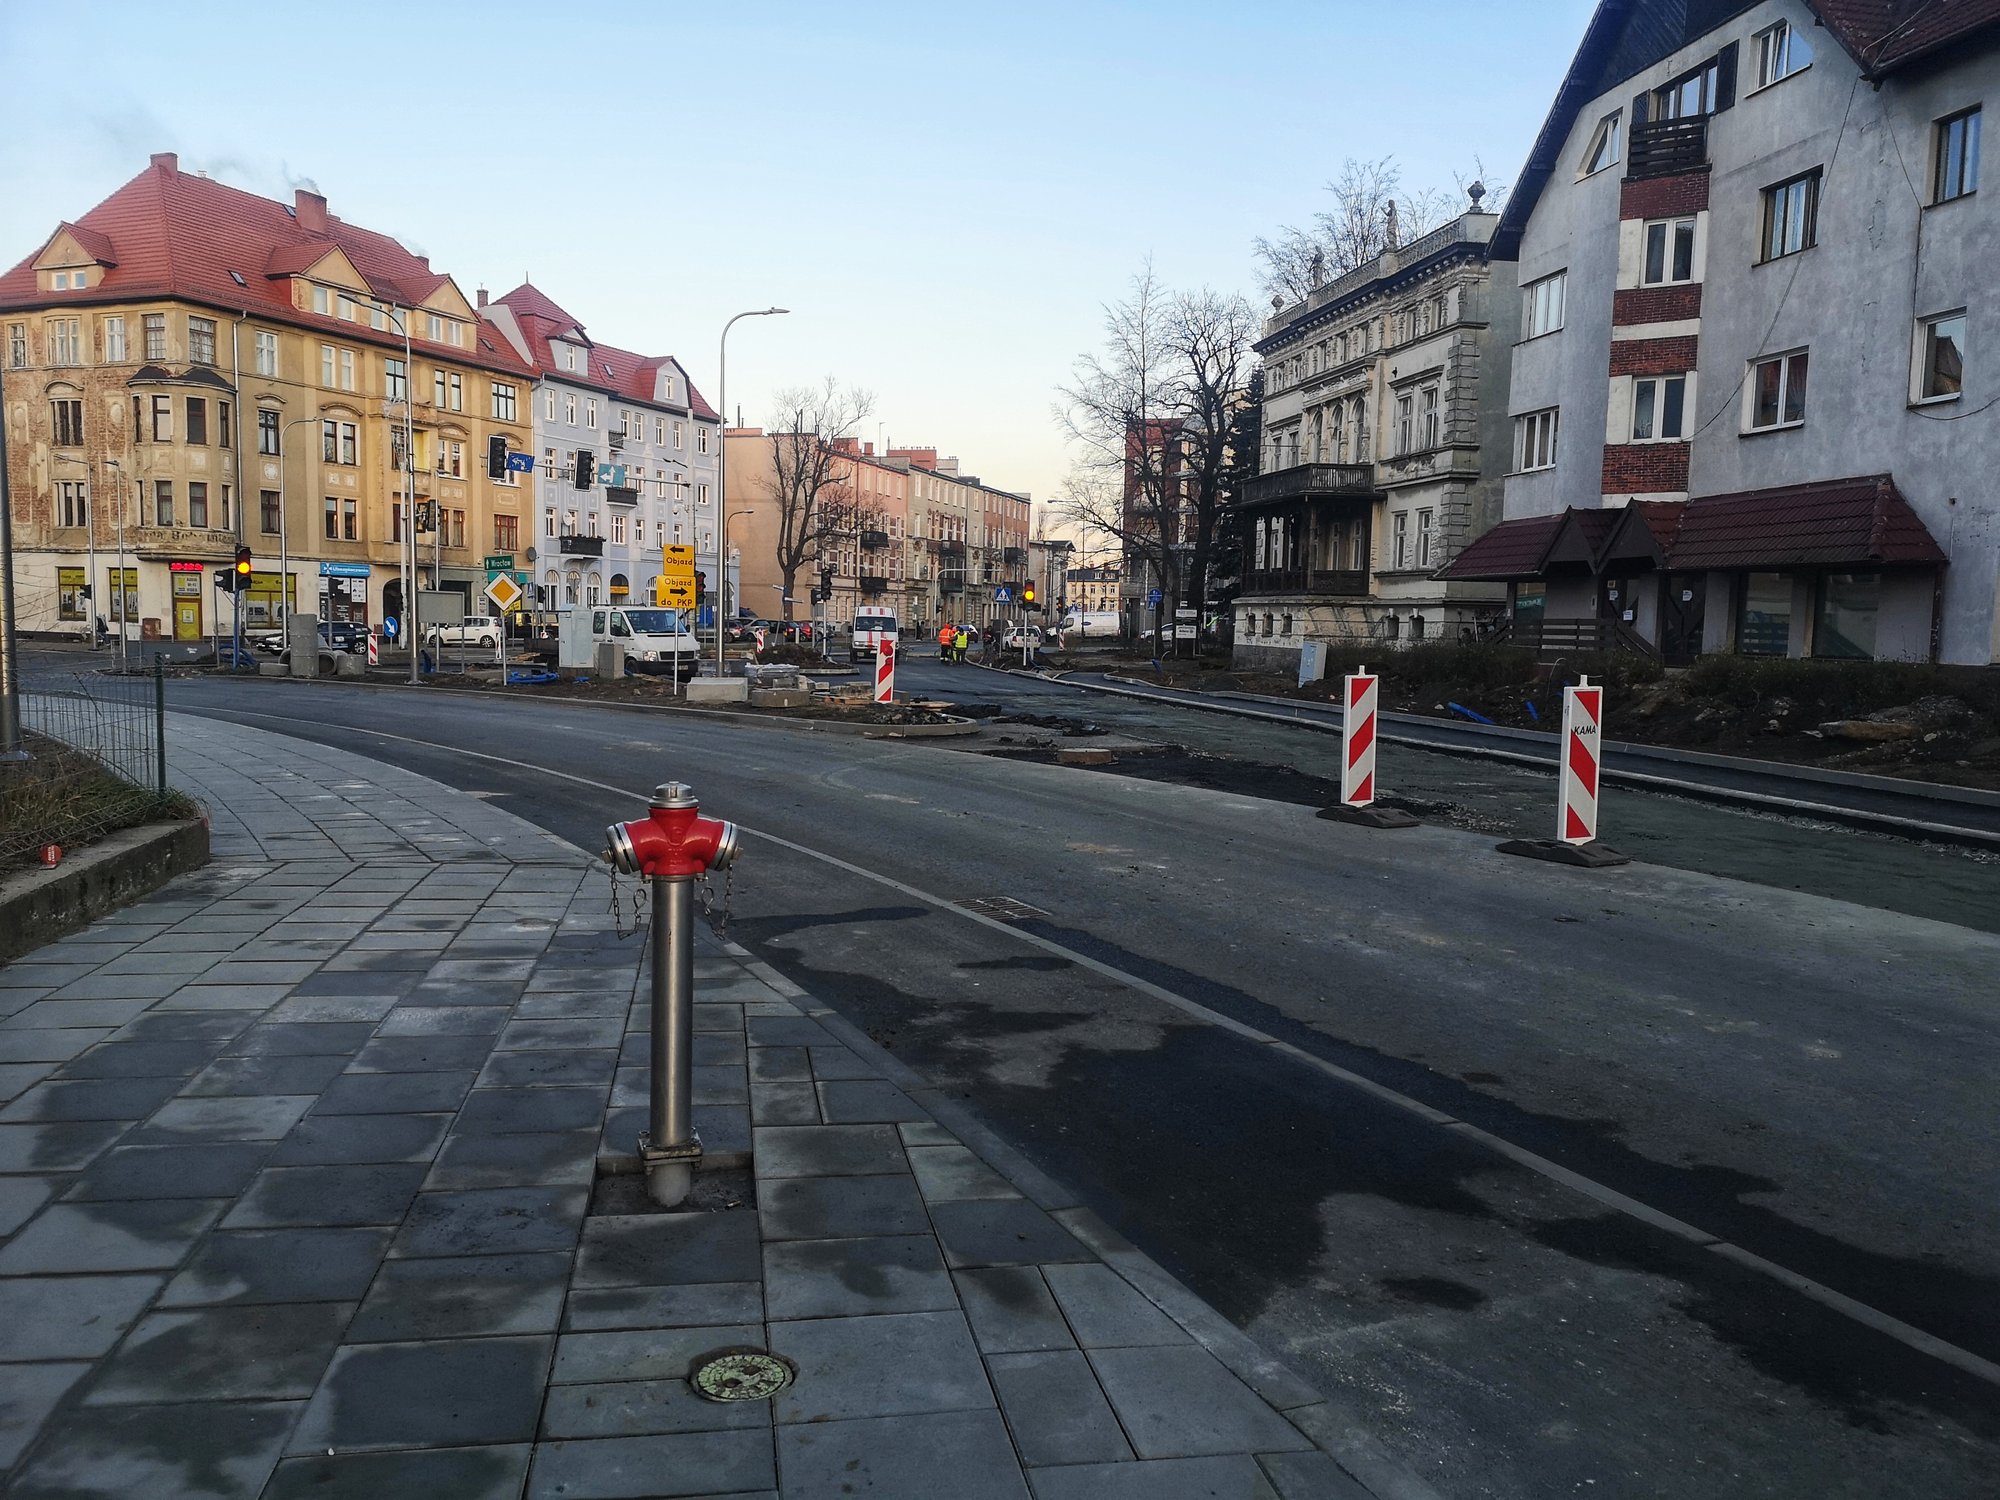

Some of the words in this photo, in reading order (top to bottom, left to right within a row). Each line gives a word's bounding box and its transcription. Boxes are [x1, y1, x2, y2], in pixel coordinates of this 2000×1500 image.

[666, 556, 693, 566] Objazd
[664, 577, 692, 587] Objazd
[660, 598, 672, 606] do
[677, 598, 693, 607] PKP
[1574, 725, 1597, 735] KAMA
